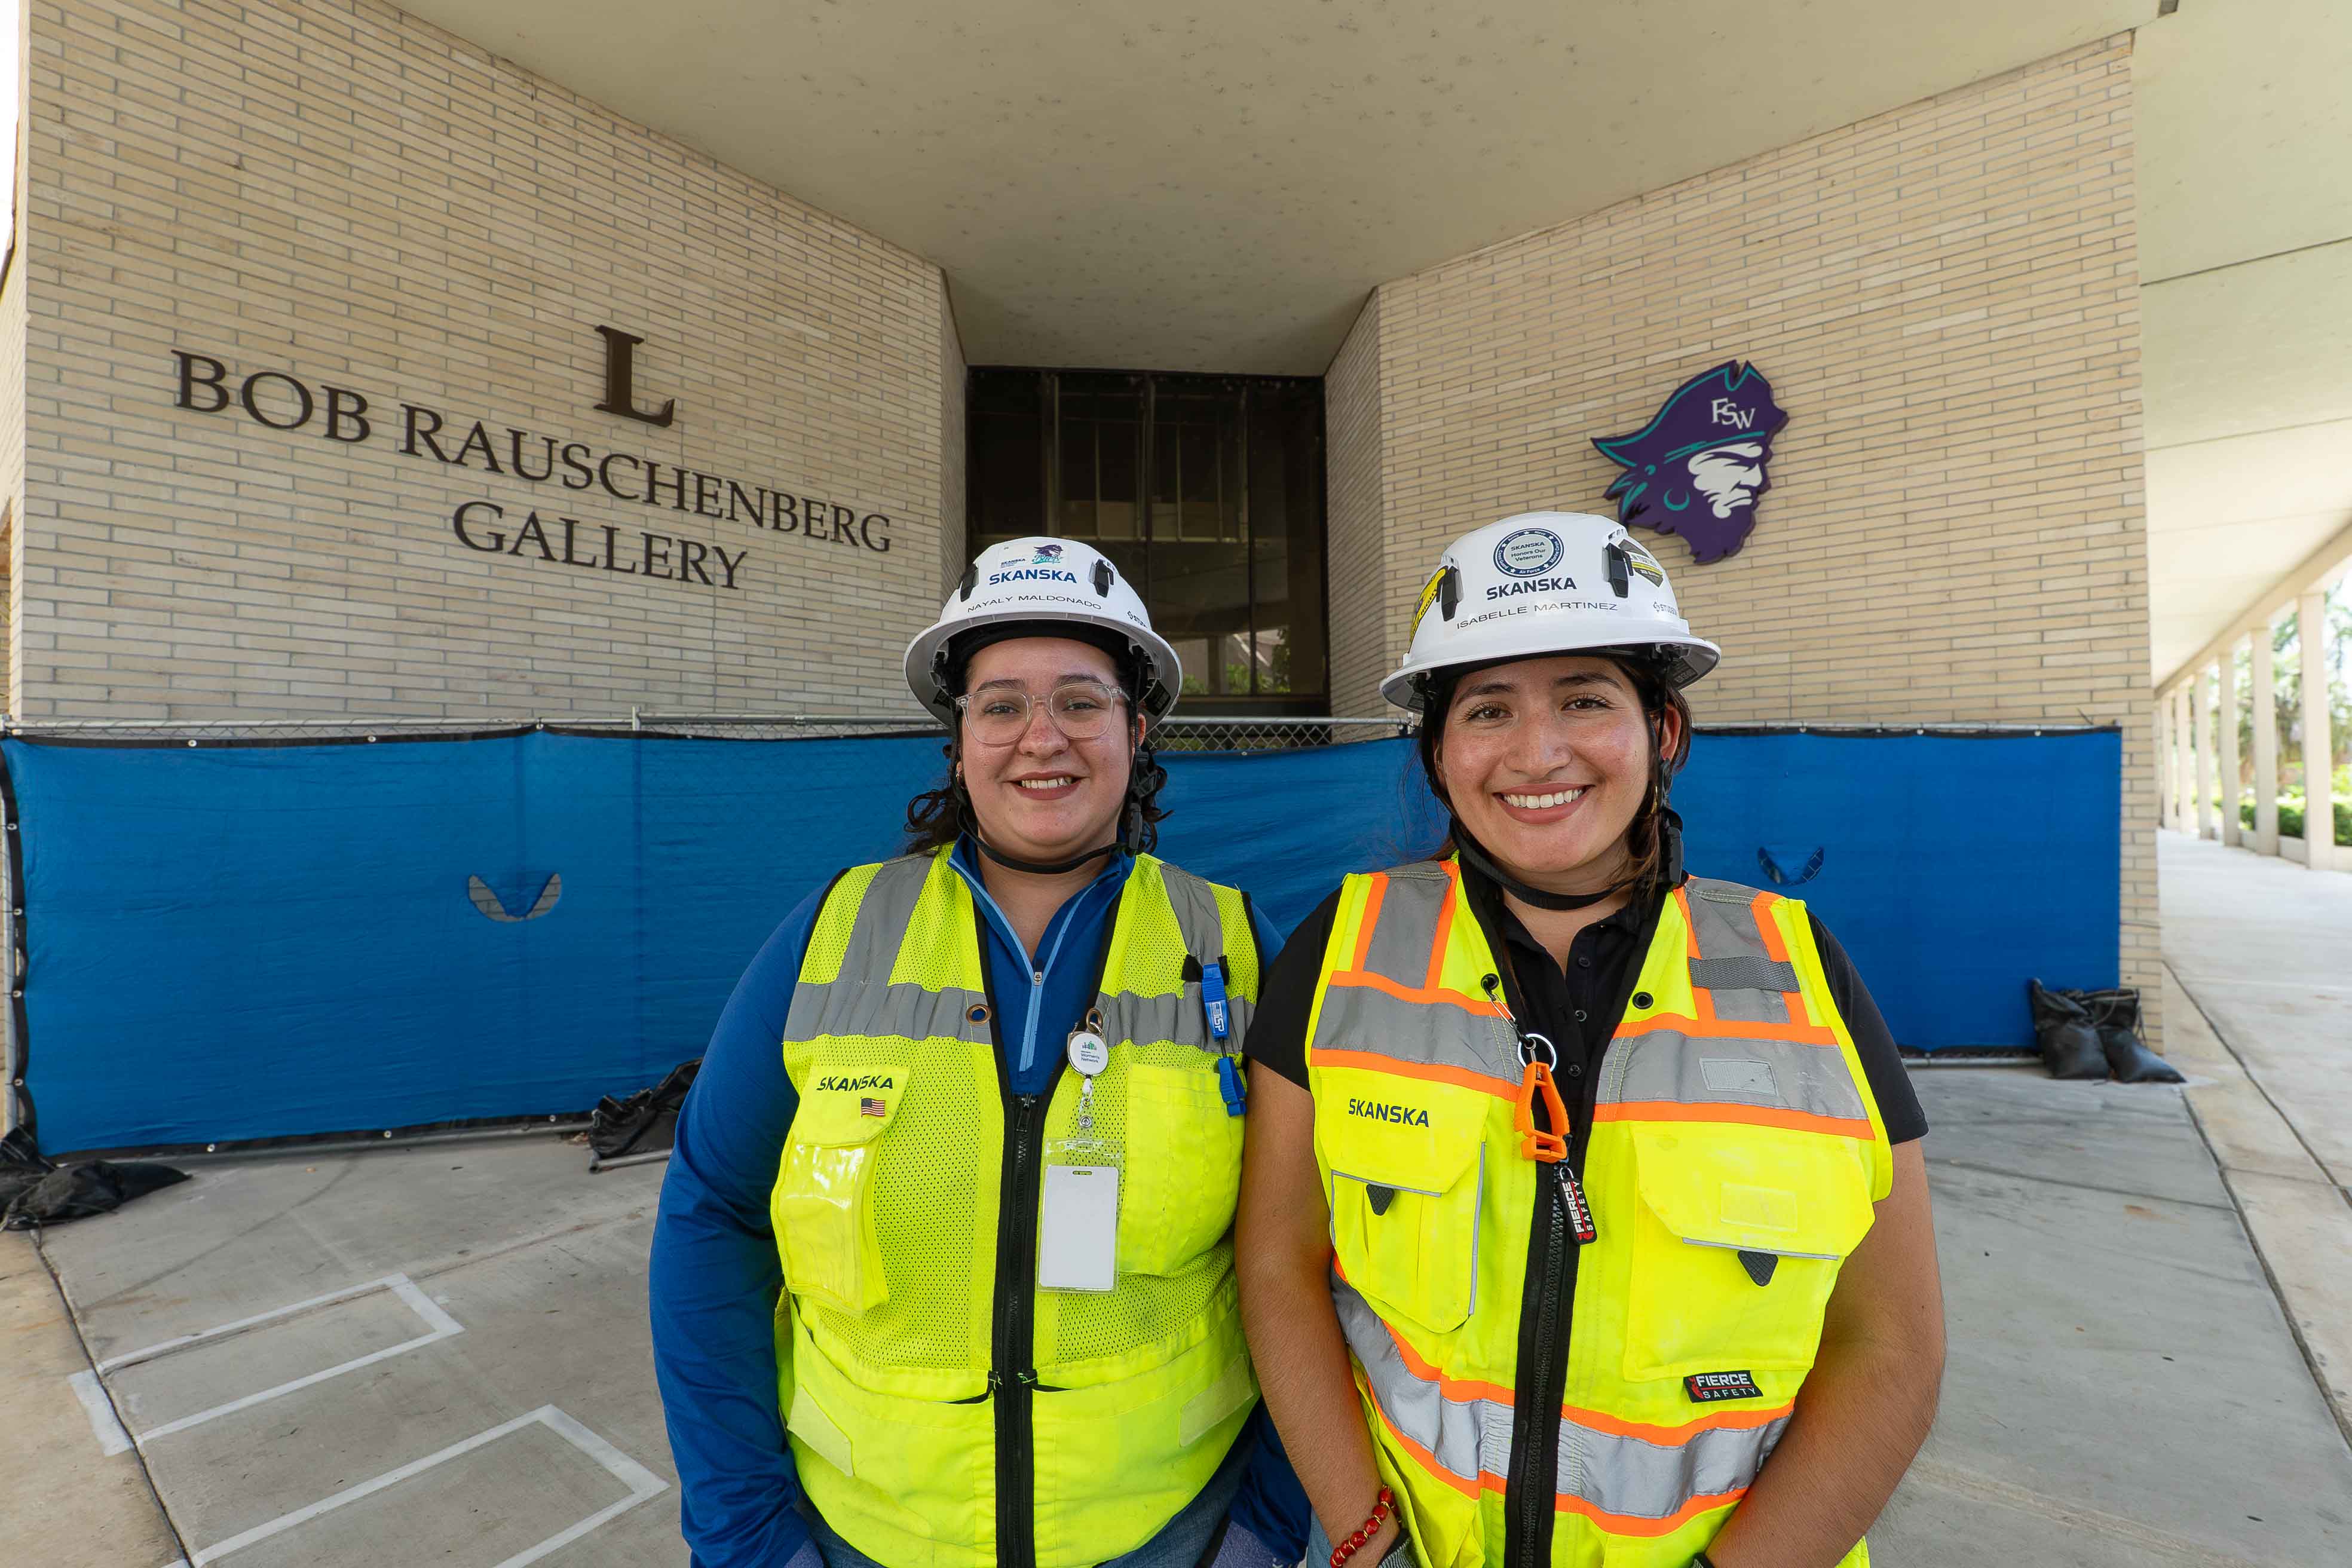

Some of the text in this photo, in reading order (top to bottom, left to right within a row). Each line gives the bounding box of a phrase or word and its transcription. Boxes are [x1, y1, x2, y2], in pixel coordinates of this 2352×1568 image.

[593, 324, 676, 428] L
[1711, 397, 1756, 430] FSW
[171, 349, 891, 553] BOB RAUSCHENBERG
[452, 501, 748, 589] GALLERY
[1511, 541, 1545, 551] SKANSKA
[989, 569, 1077, 586] SKANSKA
[1486, 577, 1577, 601] SKANSKA
[967, 595, 1102, 612] NAYALY MALDONADO
[1457, 602, 1619, 629] ISABELLE MARTINEZ
[816, 1076, 893, 1092] SKANSKA
[1348, 1098, 1429, 1128] SKANSKA
[1561, 1181, 1584, 1233] FIERCE
[1573, 1181, 1594, 1231] SAFETY
[1695, 1373, 1750, 1387] FIERCE
[1704, 1388, 1756, 1399] SAFETY
